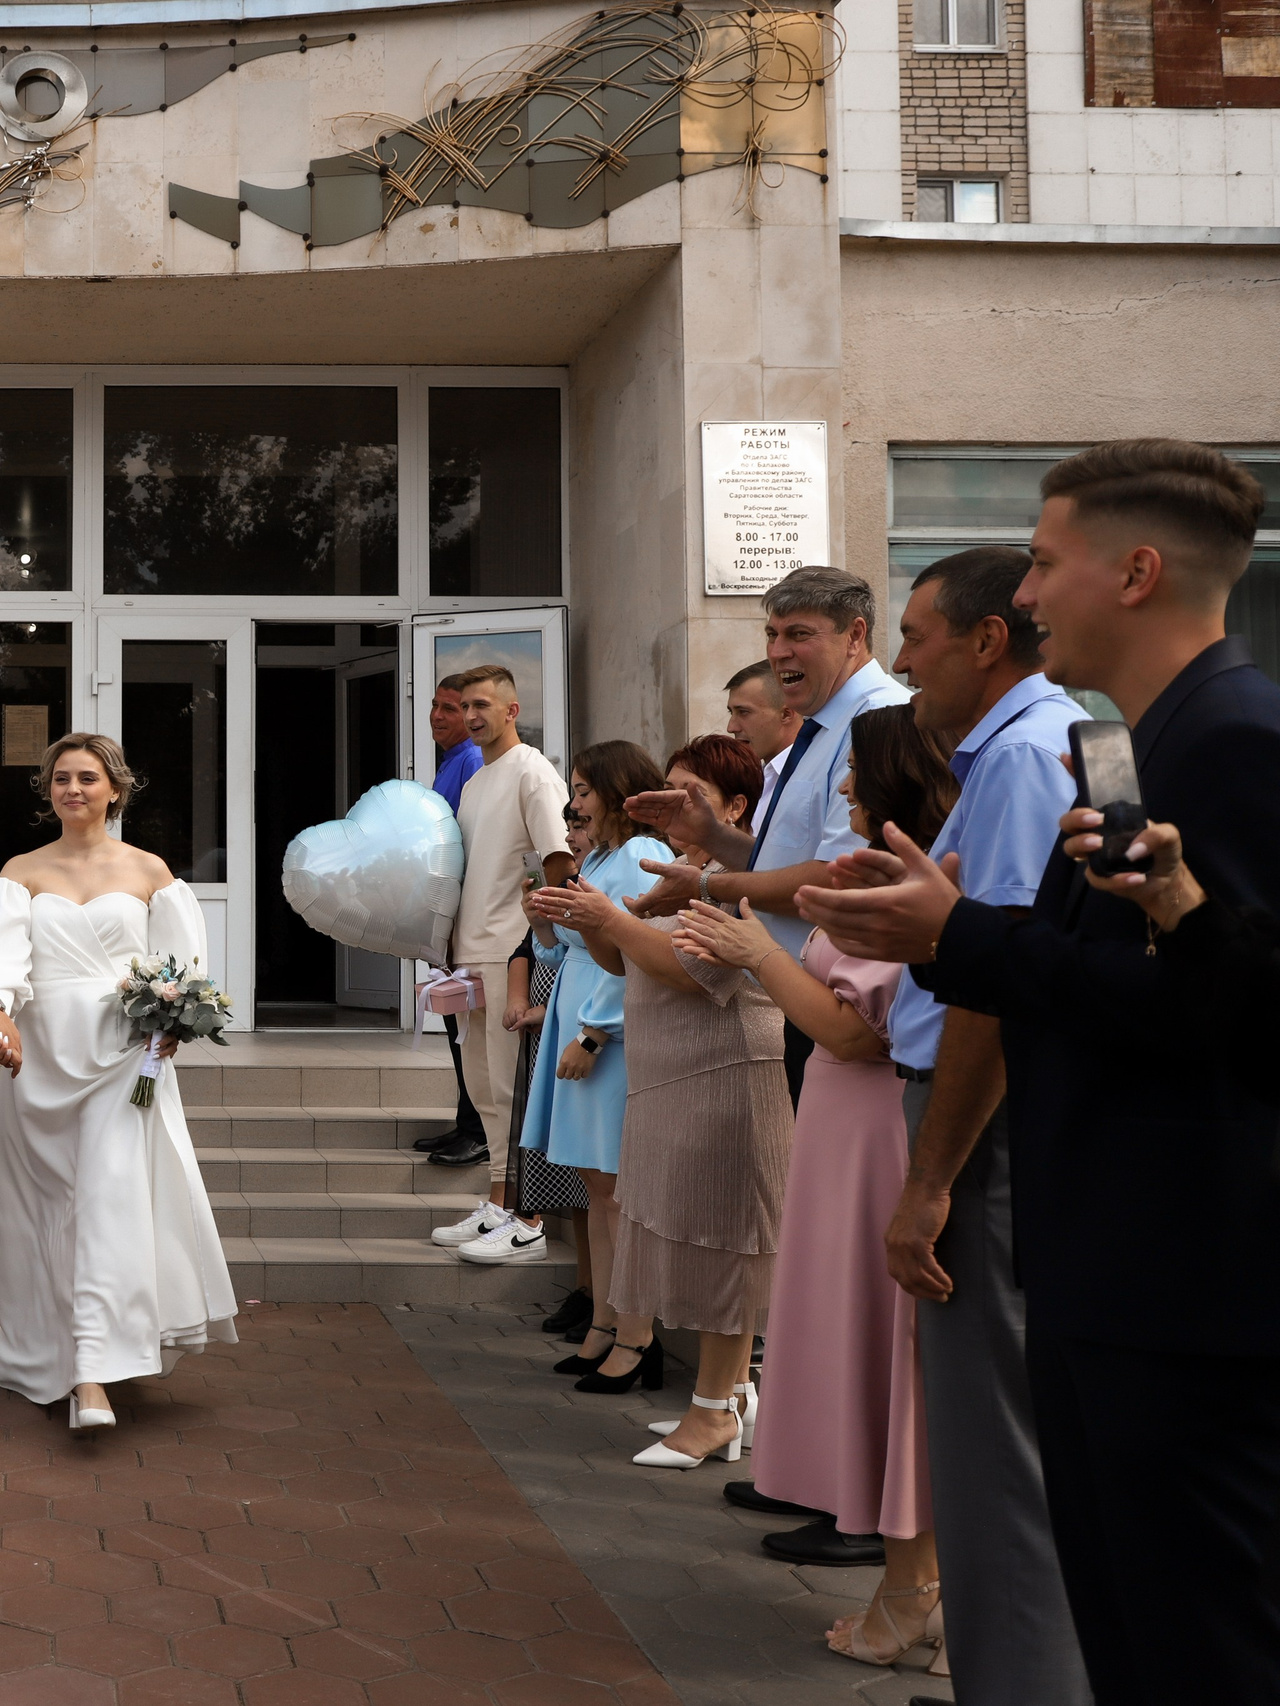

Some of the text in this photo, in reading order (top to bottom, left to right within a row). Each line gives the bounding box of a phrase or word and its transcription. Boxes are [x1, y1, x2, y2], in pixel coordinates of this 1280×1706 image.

[736, 533, 758, 541] 8.00
[770, 533, 798, 541] 17.00
[740, 547, 795, 556] перерыв:
[733, 560, 762, 569] 12.00
[774, 560, 802, 569] 13.00
